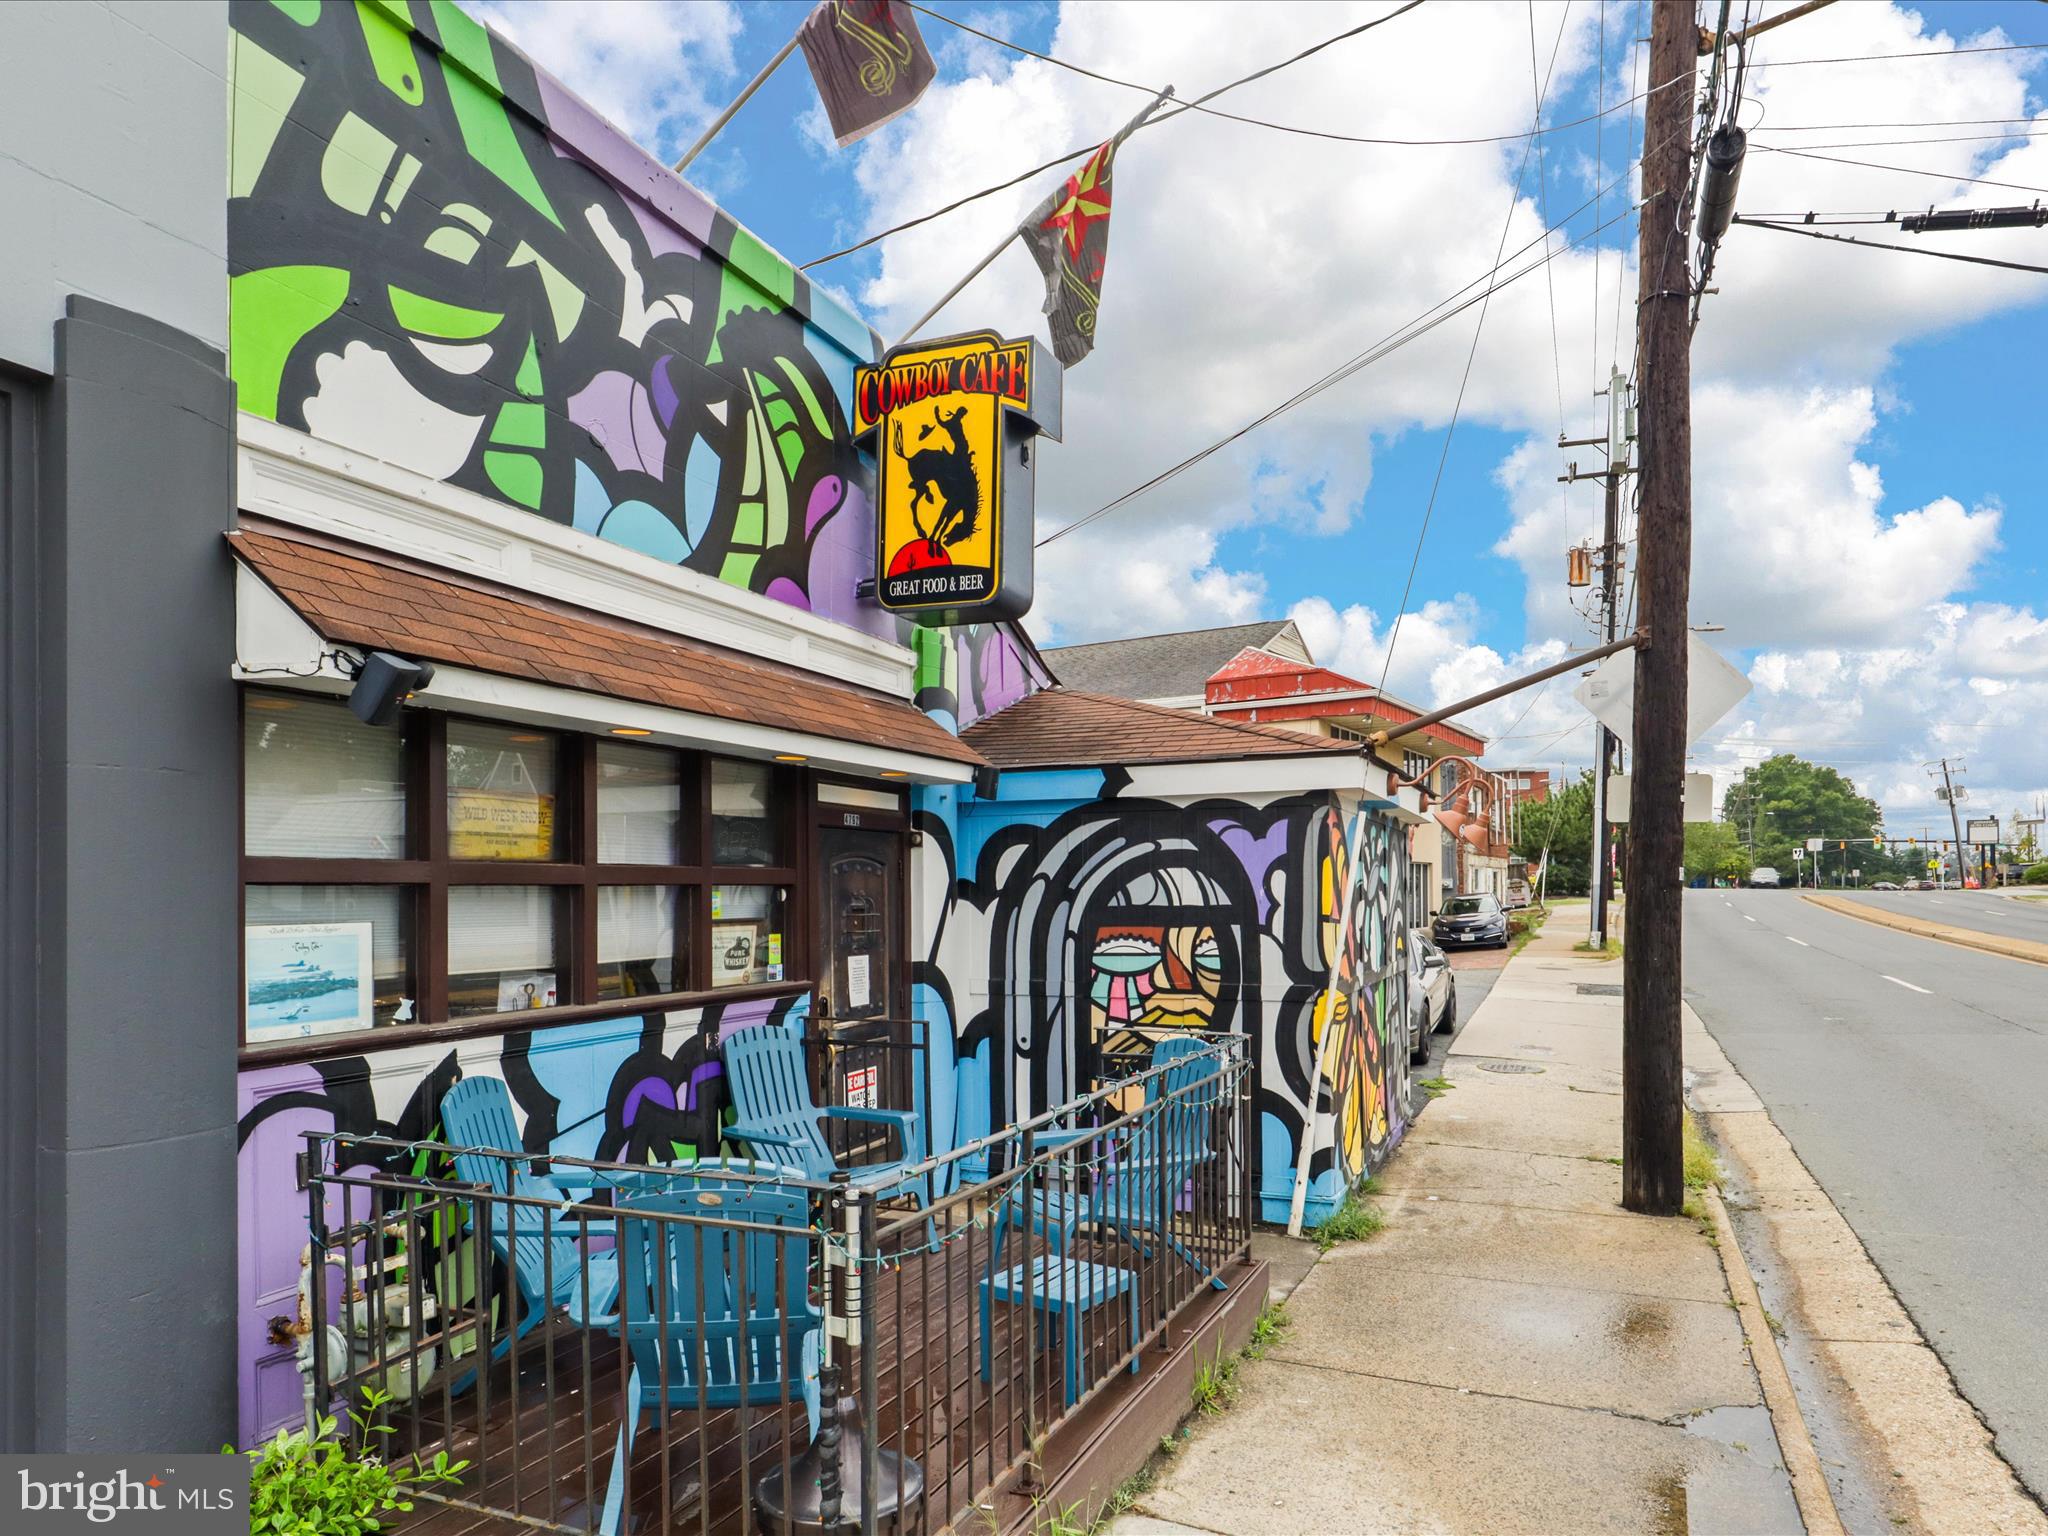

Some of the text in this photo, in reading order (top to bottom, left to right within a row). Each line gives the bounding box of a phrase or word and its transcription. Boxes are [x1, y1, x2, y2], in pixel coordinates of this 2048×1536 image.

[859, 350, 1027, 424] COWBOY CAFE
[889, 574, 984, 597] GREAT FOOD & BEER
[463, 806, 487, 820] WILD
[491, 808, 518, 822] WEST
[729, 948, 746, 957] PURE
[853, 1071, 874, 1088] CAREUL
